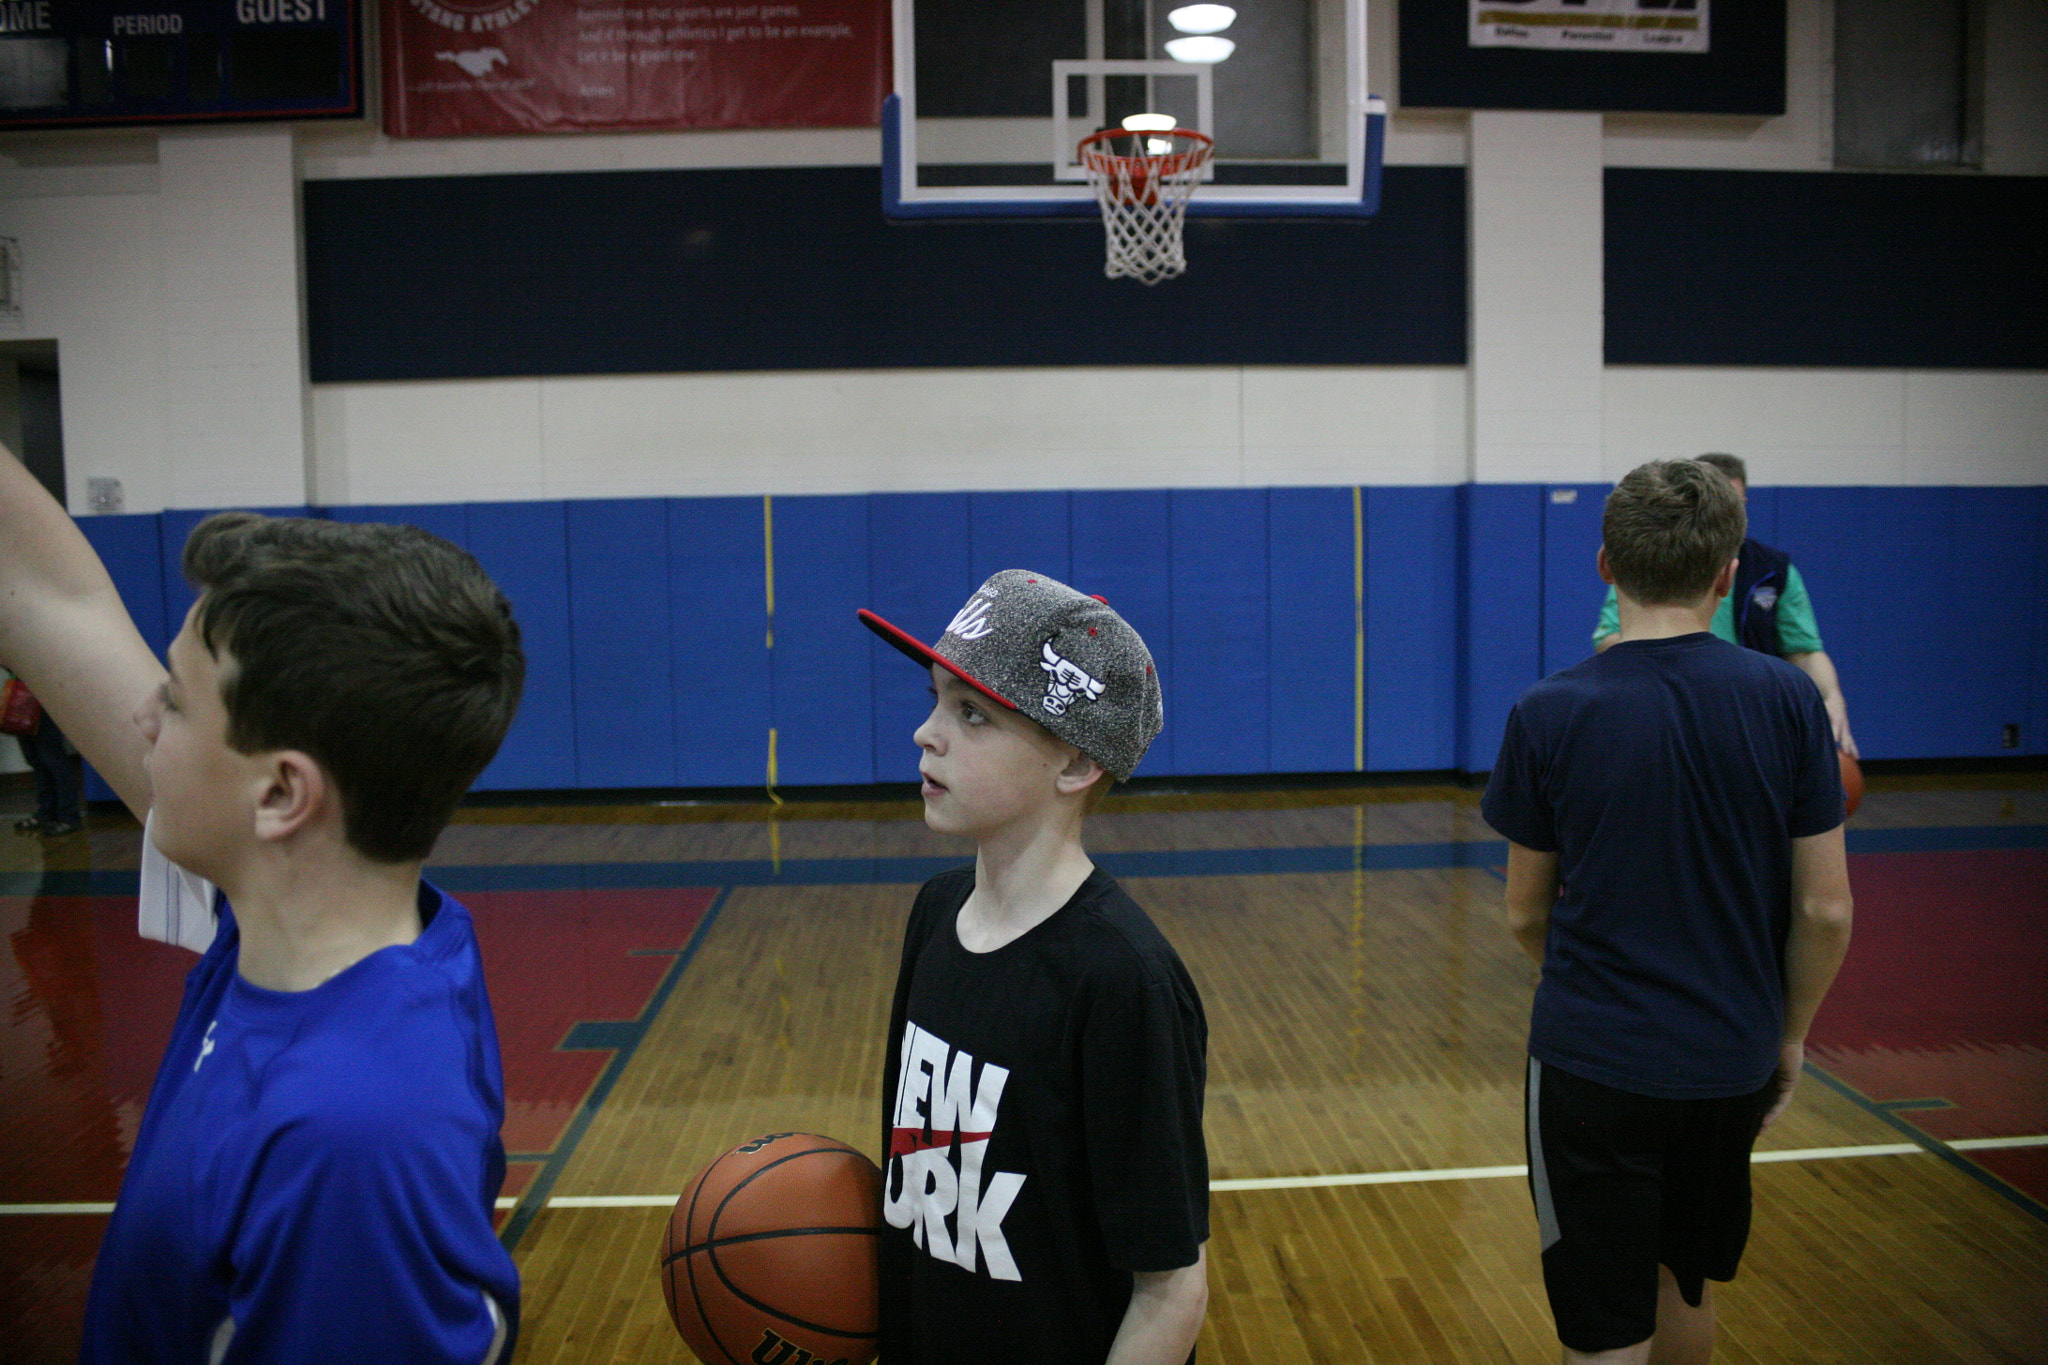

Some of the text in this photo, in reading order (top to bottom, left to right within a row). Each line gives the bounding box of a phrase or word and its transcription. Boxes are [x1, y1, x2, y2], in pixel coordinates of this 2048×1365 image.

[113, 14, 183, 35] PERIOD
[236, 0, 327, 24] GUEST
[471, 0, 540, 32] ATHLE
[883, 1138, 1027, 1282] ORK
